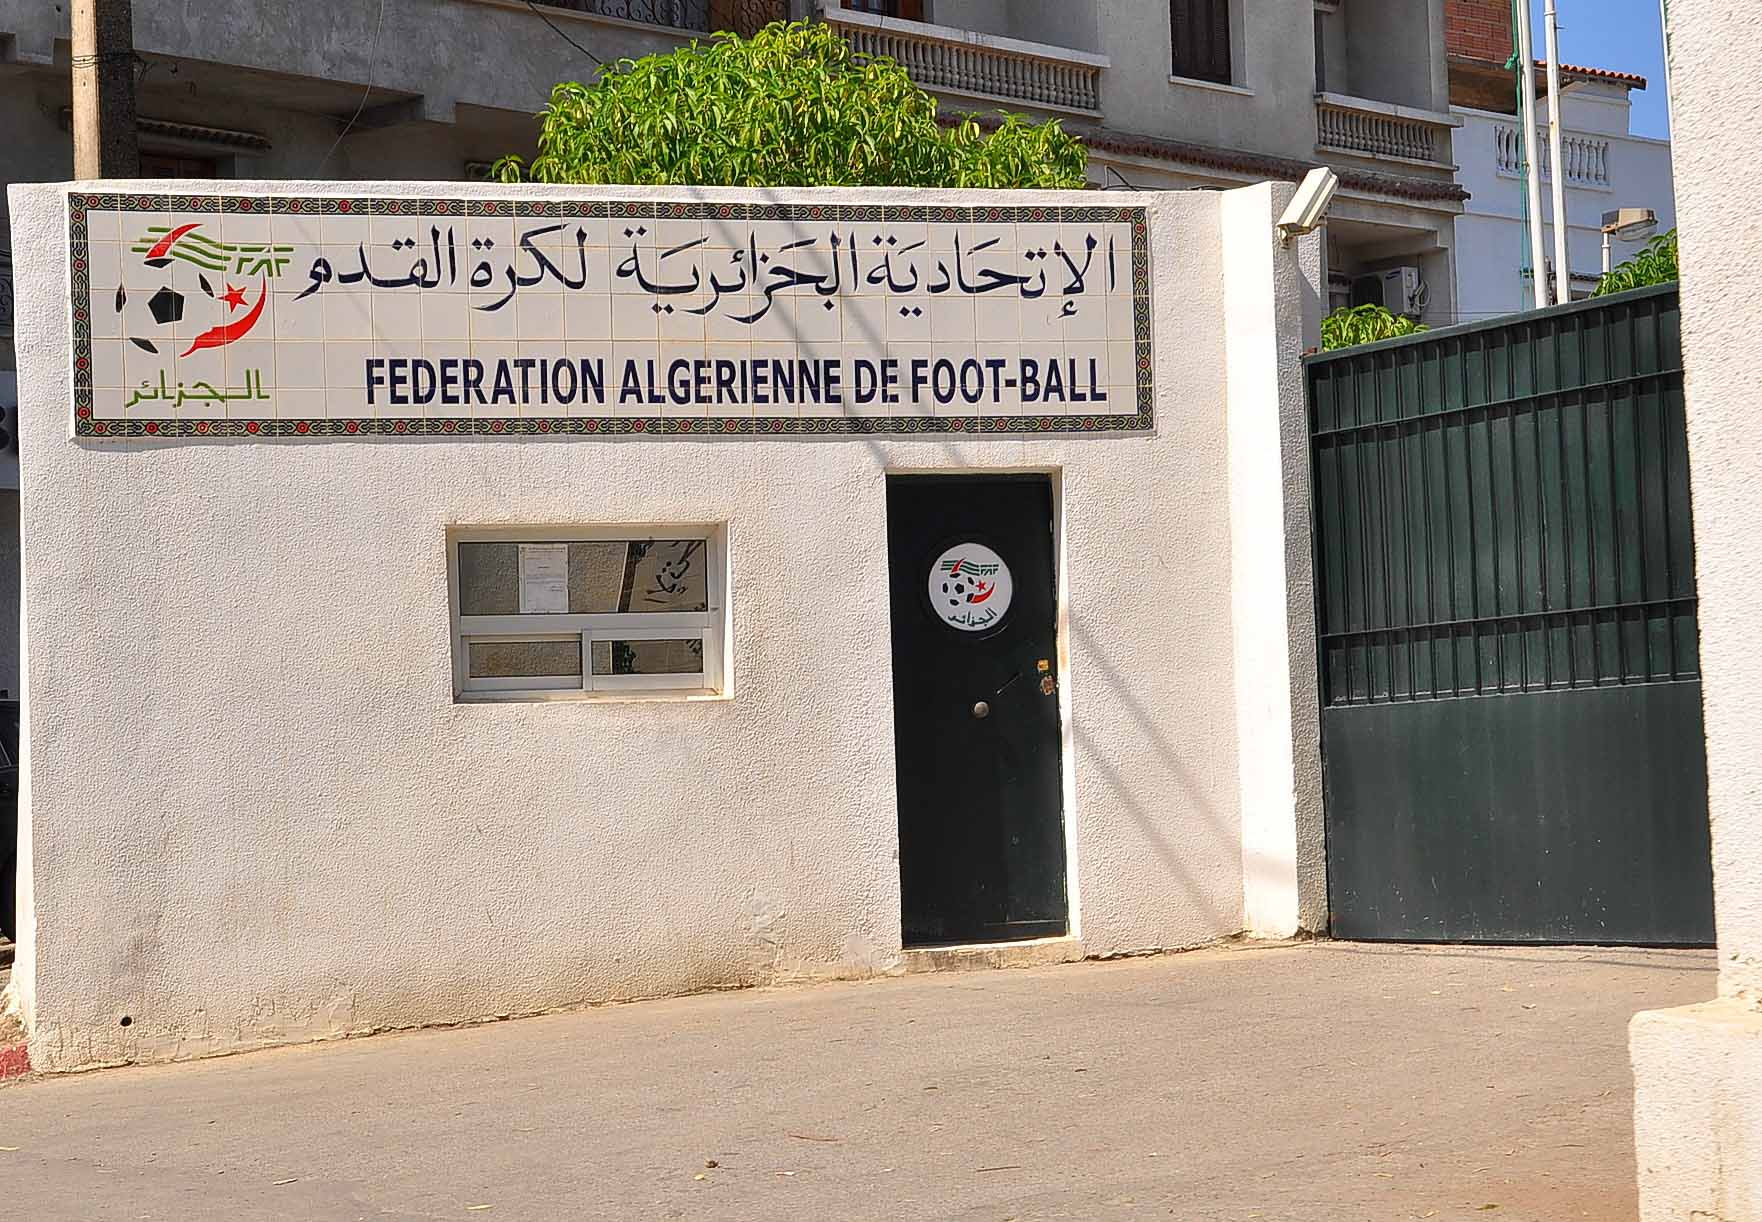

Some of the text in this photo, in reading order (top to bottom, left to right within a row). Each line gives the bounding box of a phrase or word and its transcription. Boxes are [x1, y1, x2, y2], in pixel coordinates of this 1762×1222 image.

[291, 224, 457, 302] القدم
[471, 223, 588, 312] لكرة
[125, 369, 271, 408] الجزائر
[366, 358, 1107, 405] FEDERATION ALGERIENNE DE FOOT-BALL
